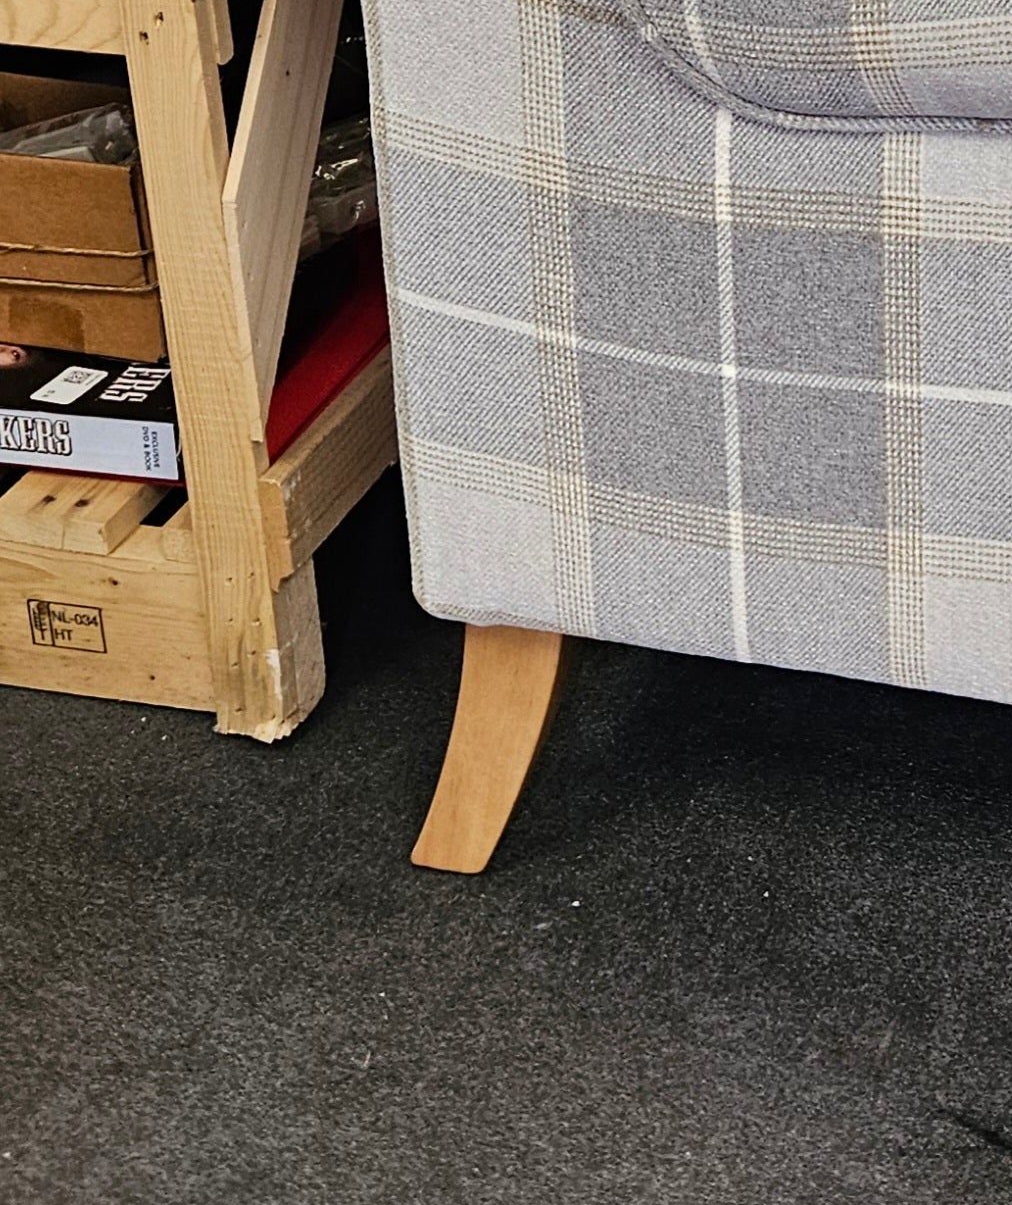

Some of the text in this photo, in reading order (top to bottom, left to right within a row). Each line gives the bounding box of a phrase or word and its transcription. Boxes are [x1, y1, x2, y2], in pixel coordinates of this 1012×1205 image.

[99, 362, 172, 403] ERS
[151, 430, 160, 468] EXCLUSIVE
[143, 450, 152, 471] BOOK
[51, 610, 99, 627] NL-034
[54, 628, 73, 641] HT
